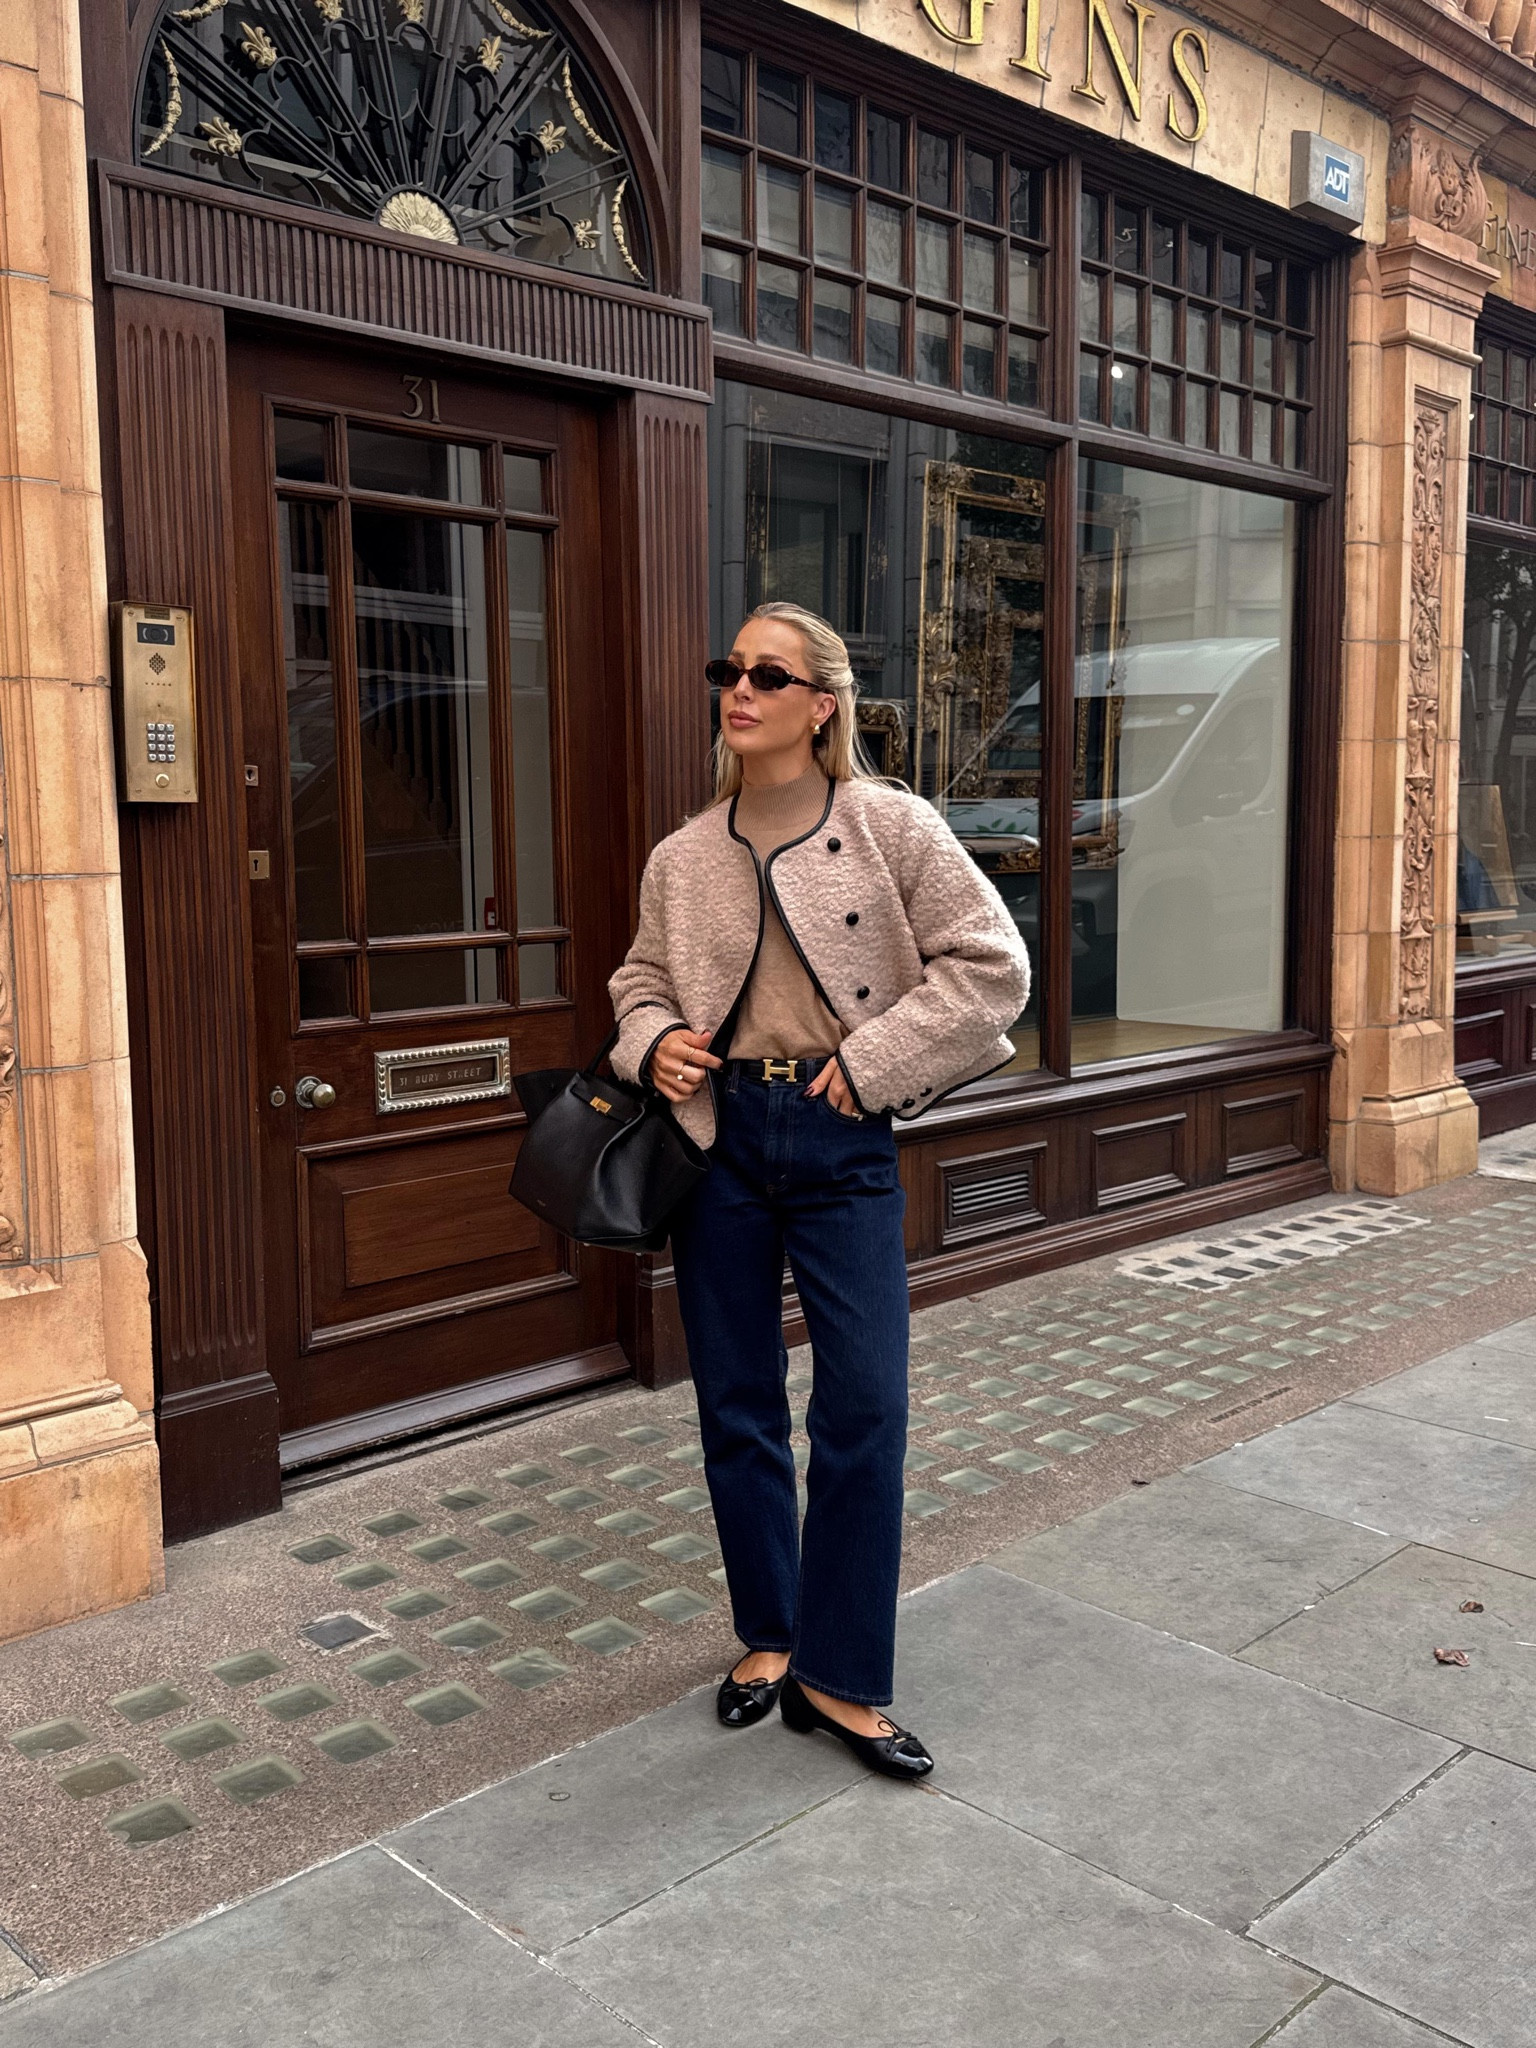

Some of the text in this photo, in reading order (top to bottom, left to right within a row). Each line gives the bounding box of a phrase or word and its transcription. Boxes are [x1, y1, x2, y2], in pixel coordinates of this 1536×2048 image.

[1324, 165, 1350, 194] ADT
[402, 374, 442, 423] 31
[399, 1077, 408, 1087] 31
[415, 1072, 440, 1084] BURY
